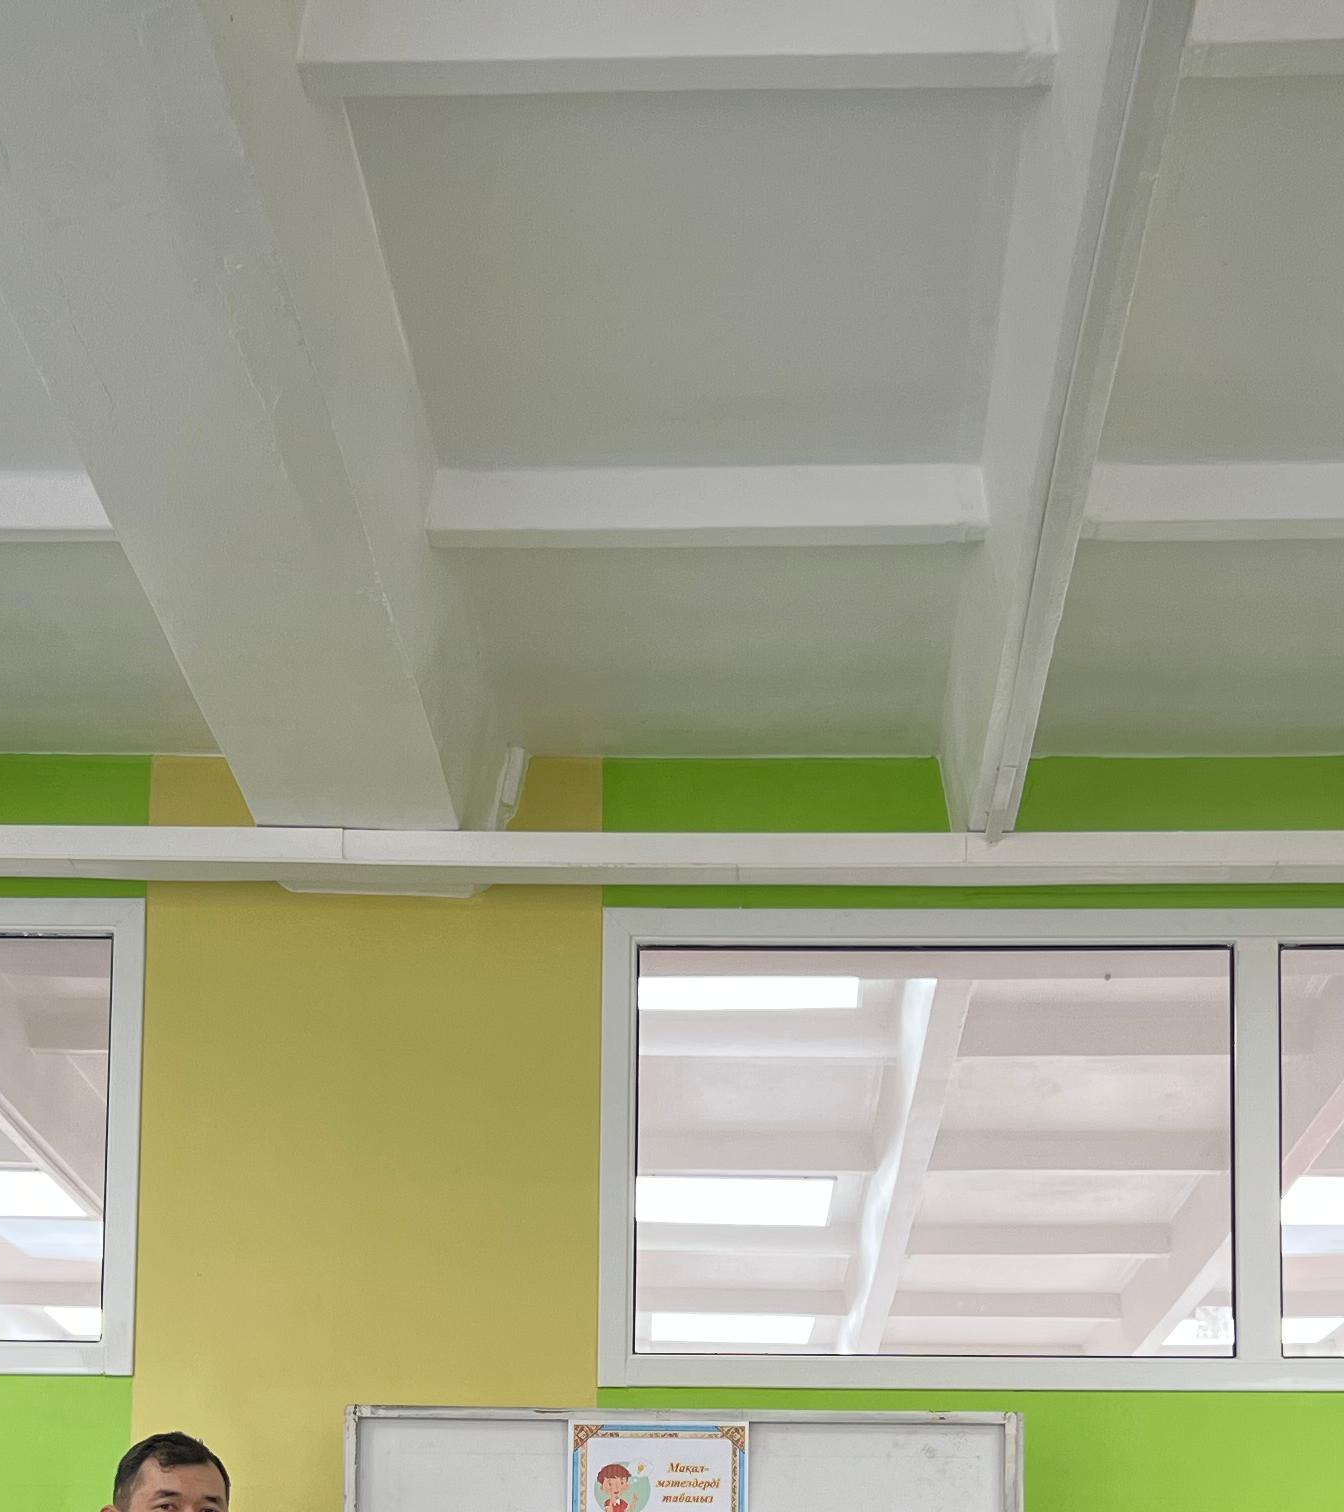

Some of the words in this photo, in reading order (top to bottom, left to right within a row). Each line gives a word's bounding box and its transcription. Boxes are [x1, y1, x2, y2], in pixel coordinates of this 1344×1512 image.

[667, 1462, 709, 1475] Мақал-
[656, 1478, 721, 1491] мәтелдерді
[661, 1493, 714, 1503] табамыз
